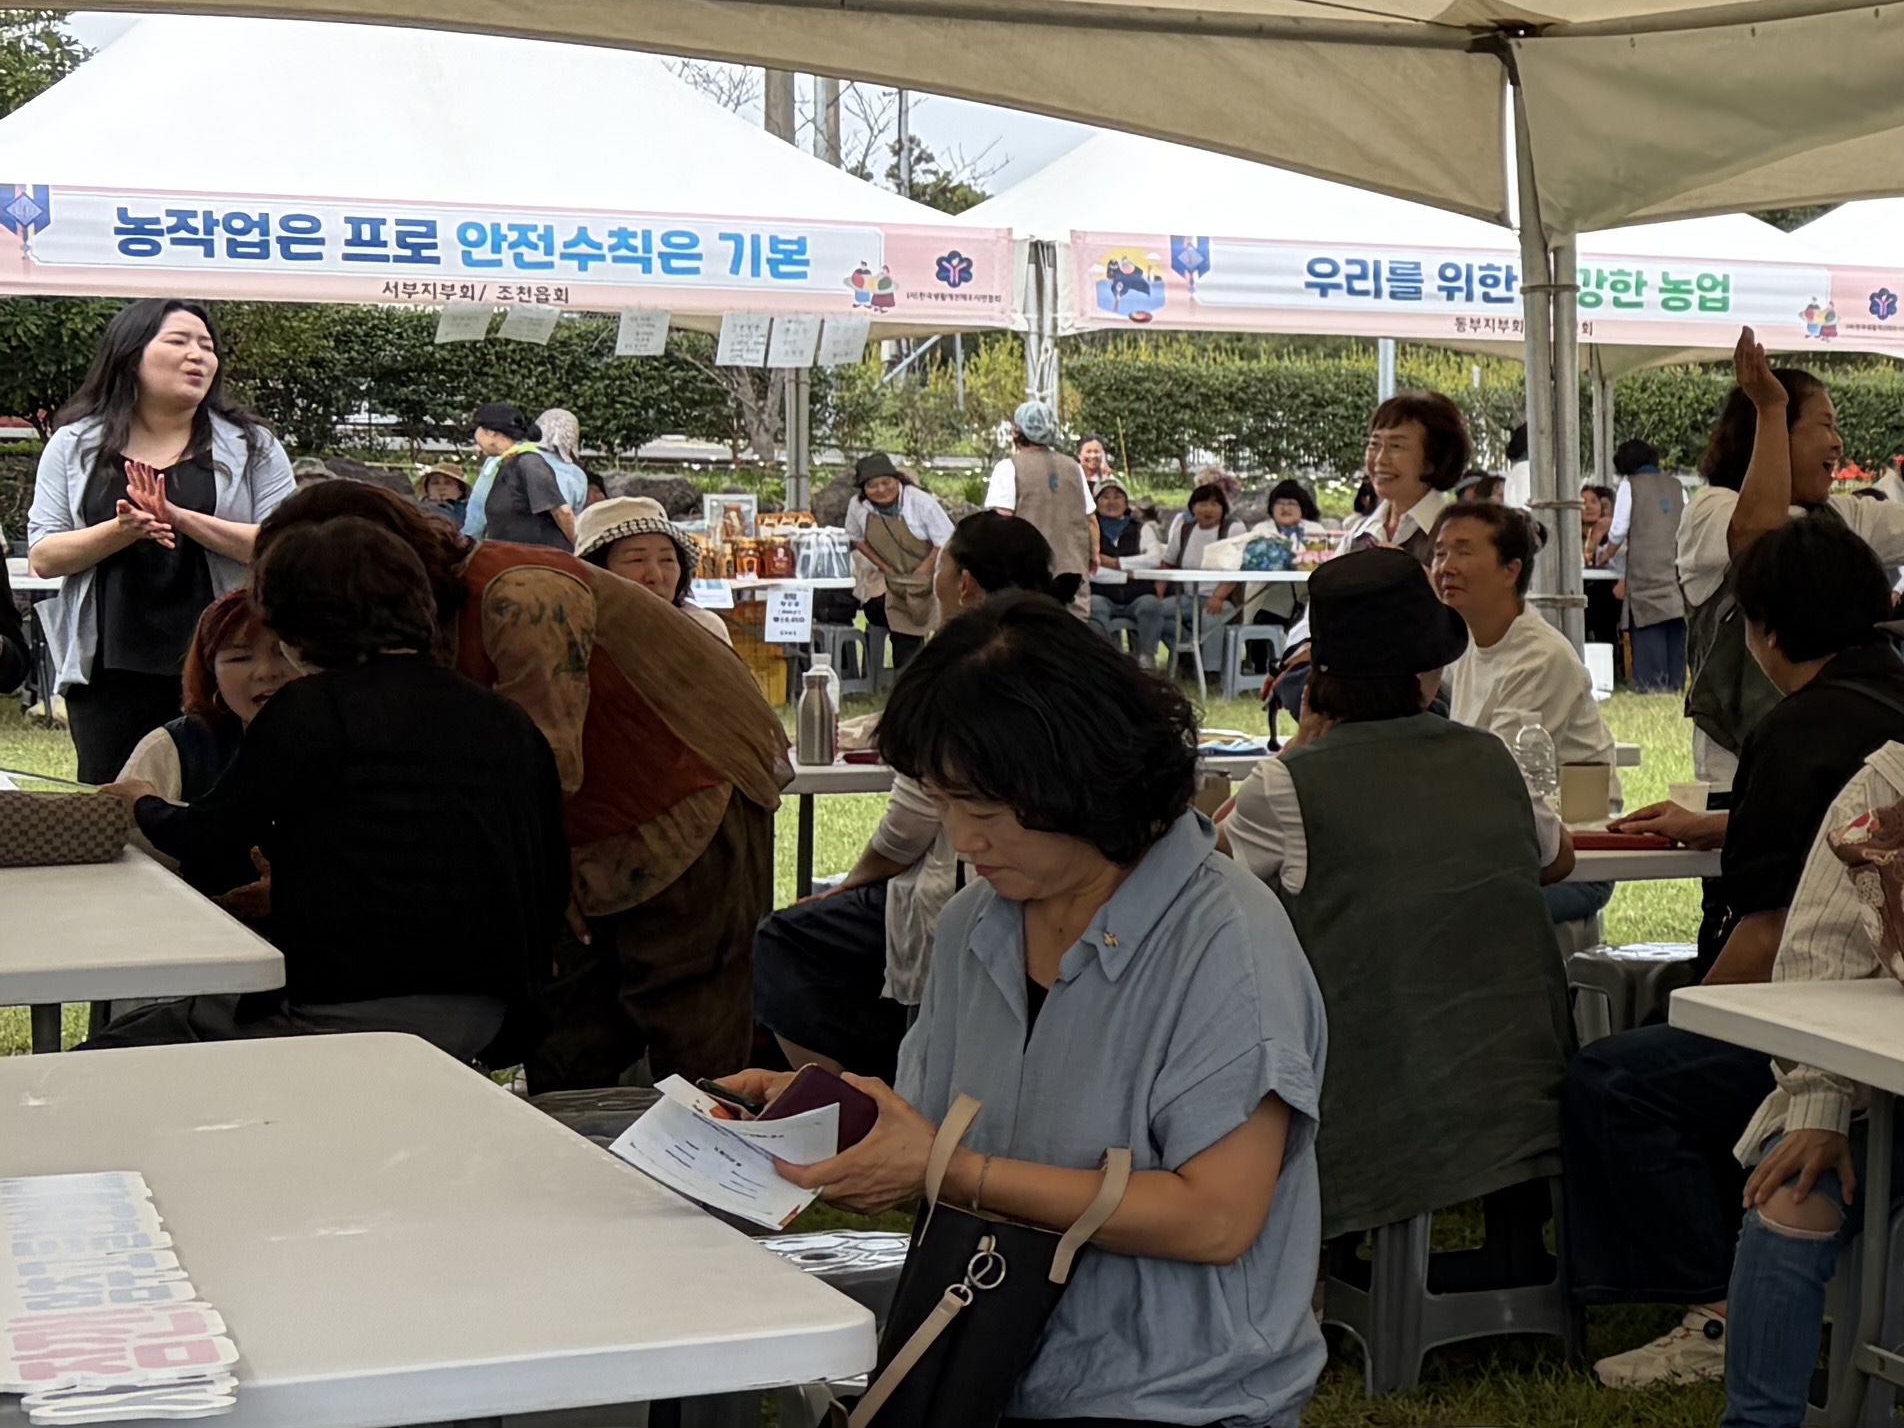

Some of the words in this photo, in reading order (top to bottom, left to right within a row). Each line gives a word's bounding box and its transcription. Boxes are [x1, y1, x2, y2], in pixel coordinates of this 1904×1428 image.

[113, 206, 326, 262] 농작업은
[341, 216, 441, 265] 프로
[456, 221, 703, 276] 안전수칙은
[718, 231, 811, 279] 기본
[382, 280, 487, 302] 서부지부회/
[496, 285, 569, 304] 조천읍회
[1304, 256, 1424, 302] 우리를
[1437, 262, 1518, 304] 위한
[1577, 267, 1647, 309] 강한
[1658, 271, 1730, 313] 농업
